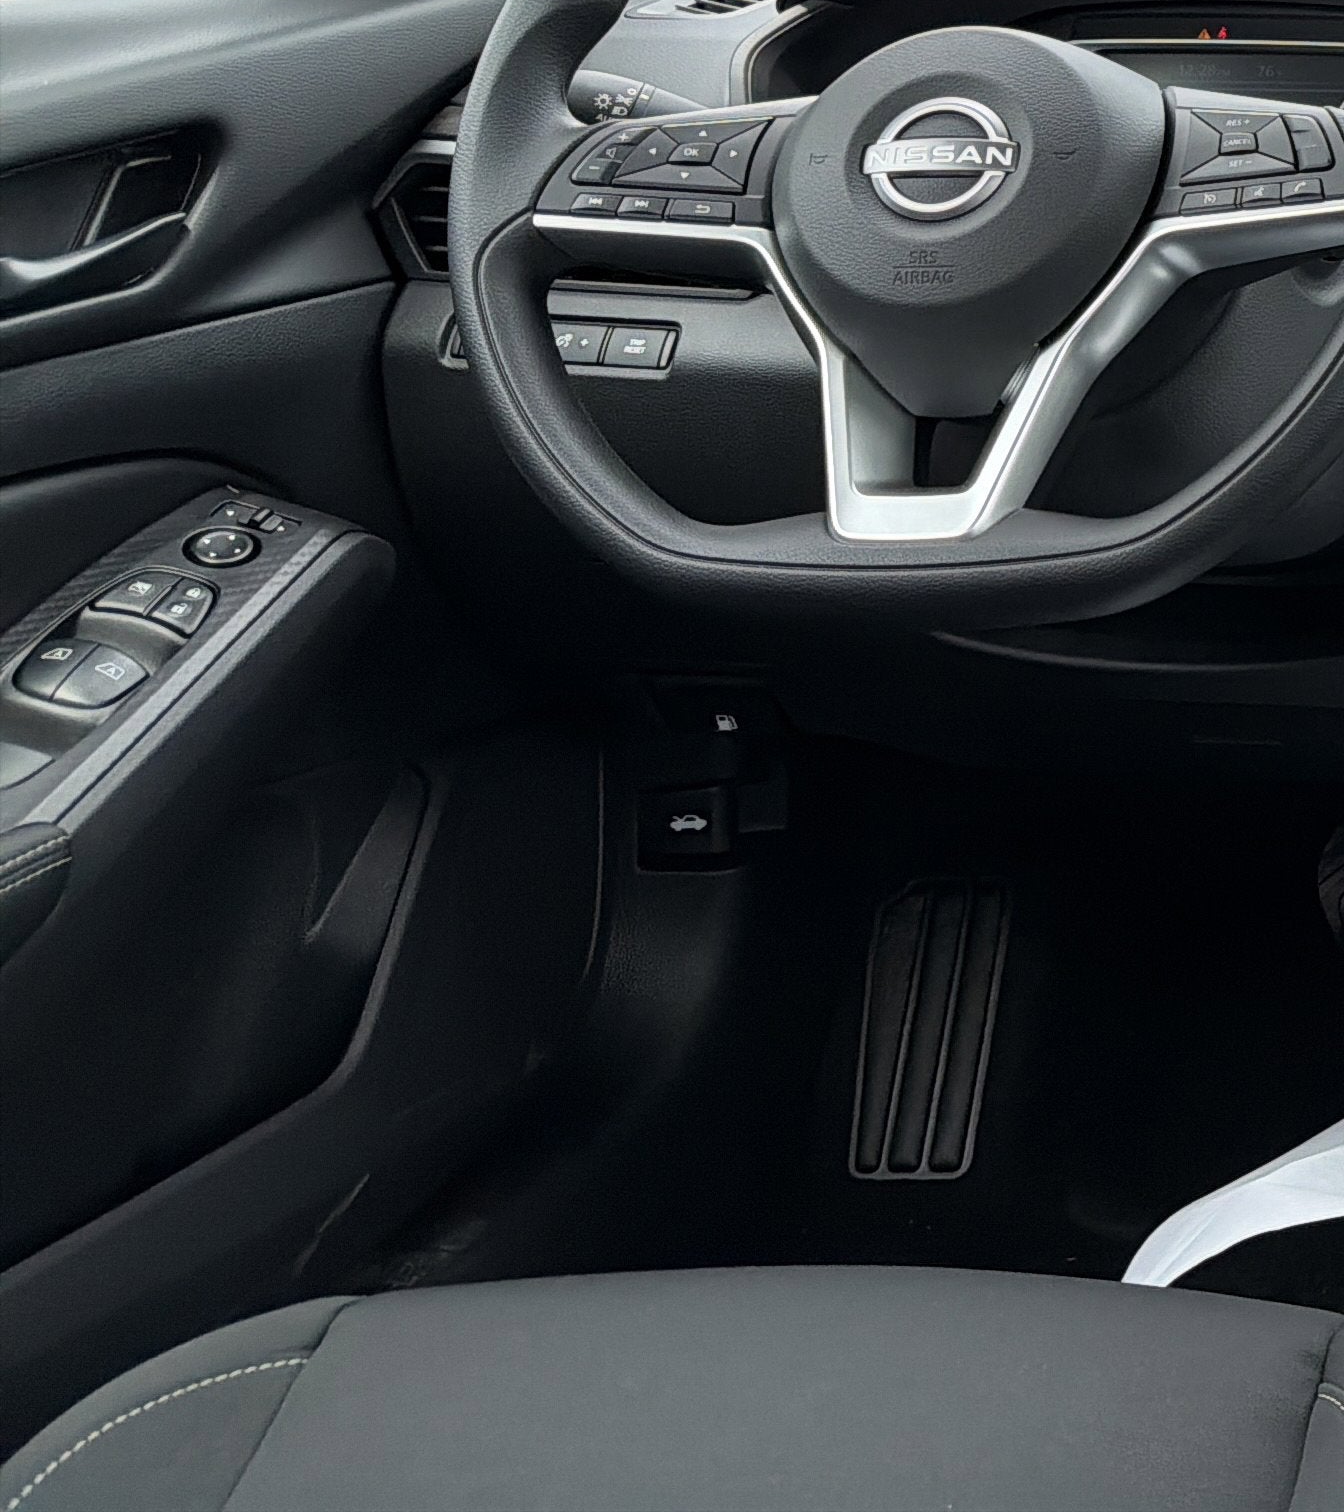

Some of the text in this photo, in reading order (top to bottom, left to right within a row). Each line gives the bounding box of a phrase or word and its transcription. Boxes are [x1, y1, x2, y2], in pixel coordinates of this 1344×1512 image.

[683, 148, 699, 156] OK
[868, 145, 1013, 170] NISSAN
[909, 251, 939, 264] SRS
[893, 270, 954, 285] AIRBAG
